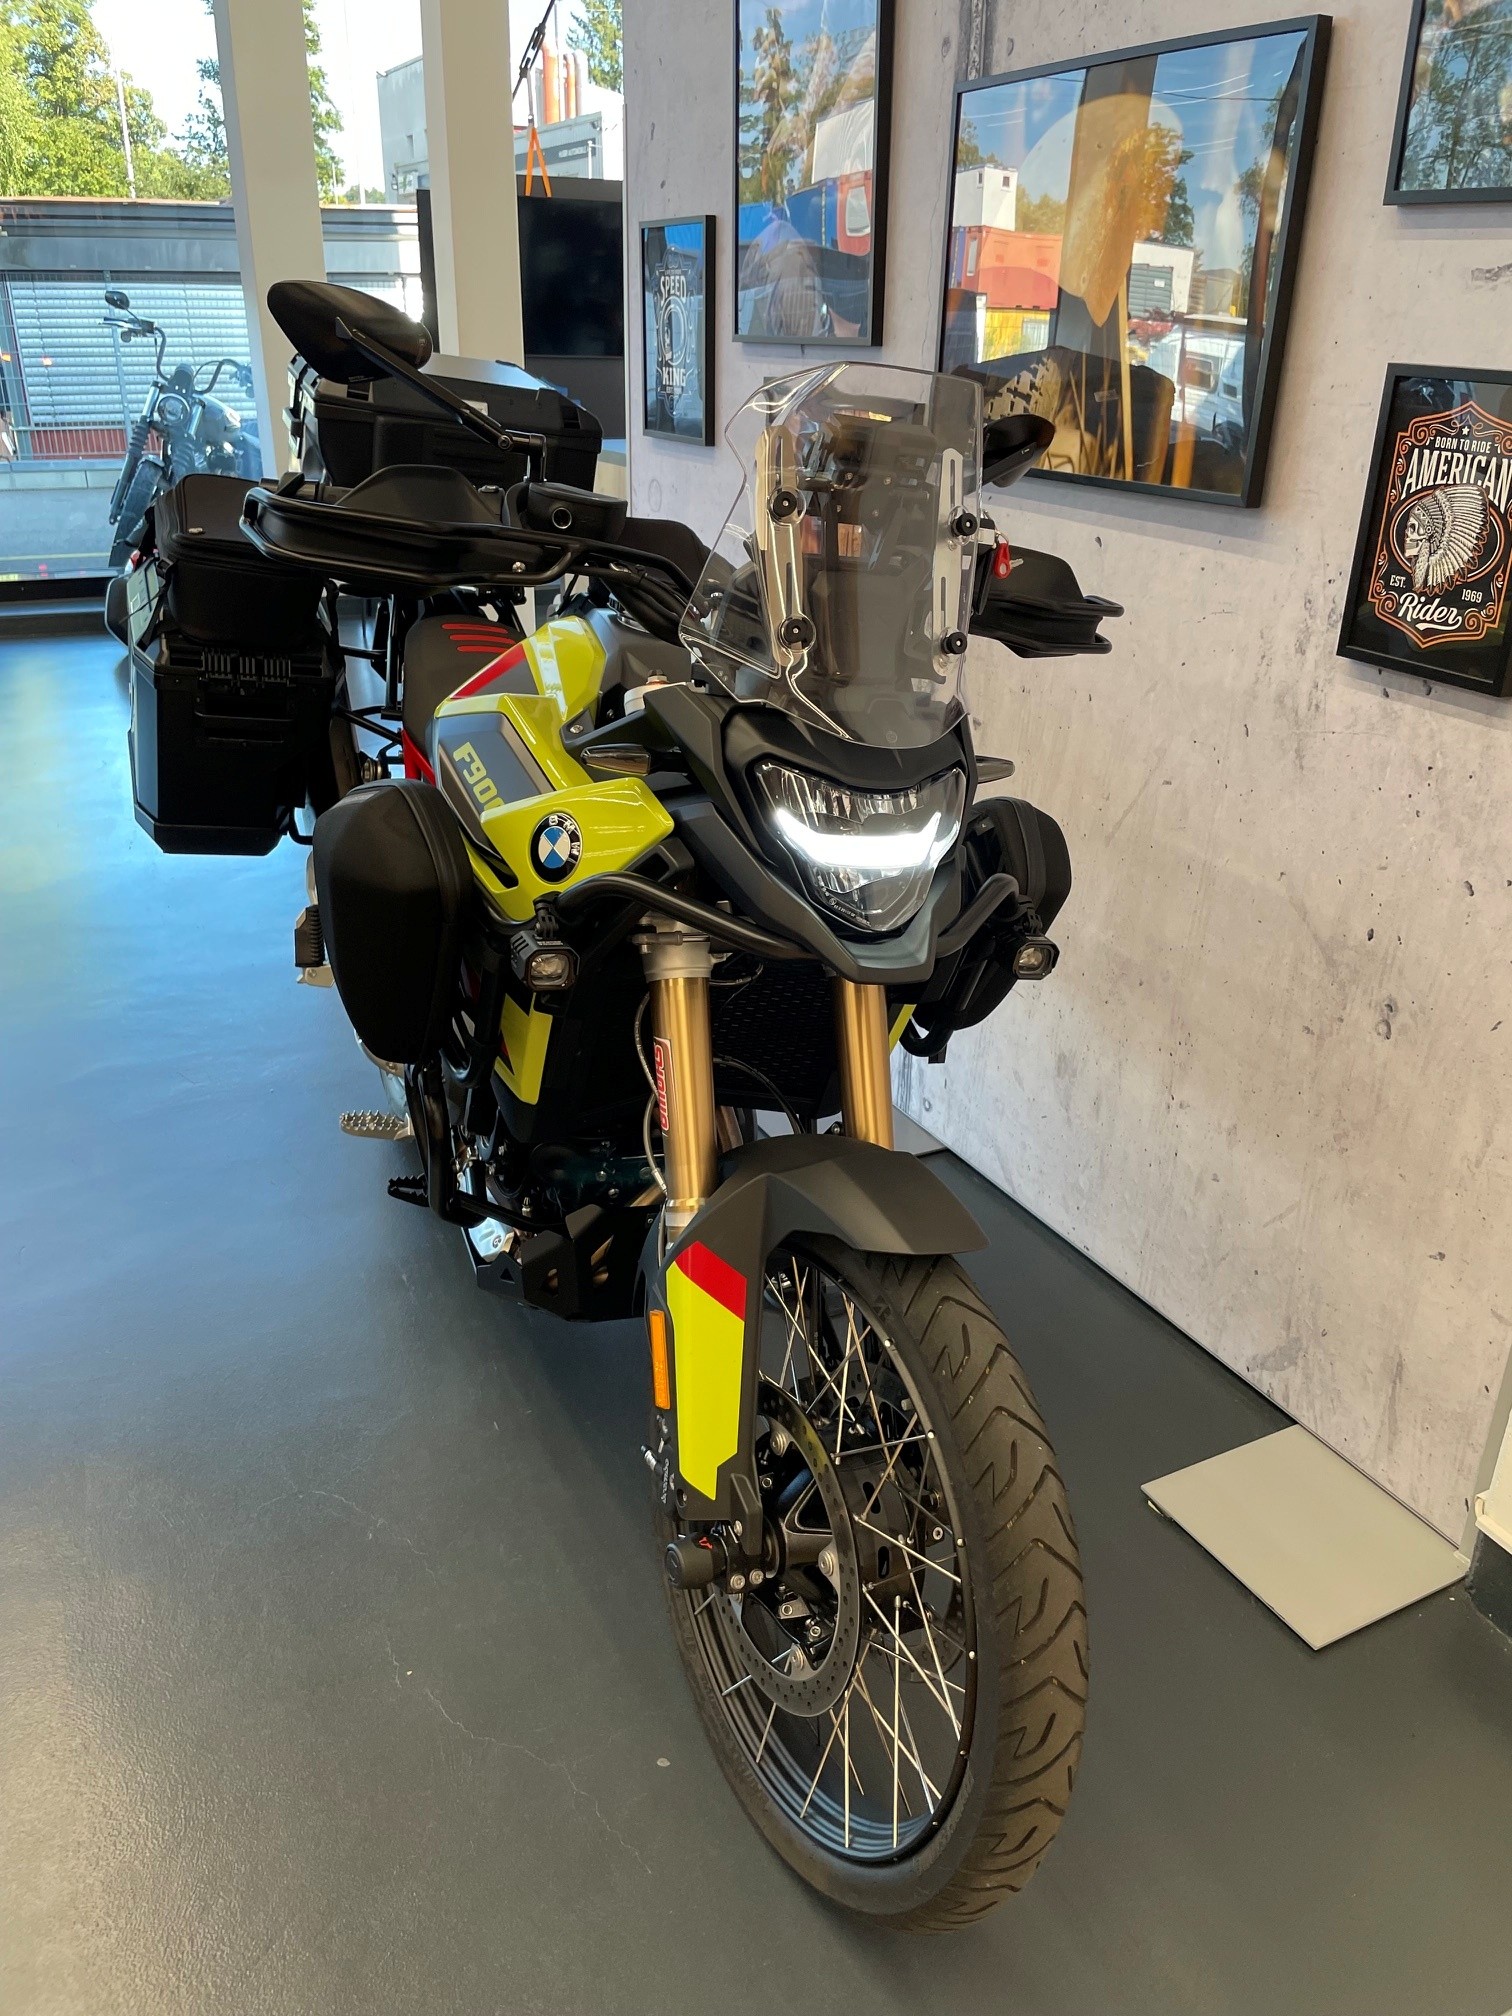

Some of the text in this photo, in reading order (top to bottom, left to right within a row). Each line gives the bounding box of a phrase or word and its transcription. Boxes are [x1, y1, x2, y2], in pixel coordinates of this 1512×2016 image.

[660, 275, 687, 305] SPEED
[662, 366, 687, 387] KING
[1435, 436, 1492, 454] BORN TO RIDE
[1400, 447, 1512, 514] AMERICAN
[1389, 574, 1407, 589] EST.
[1461, 588, 1483, 603] 1969
[1397, 592, 1463, 631] Rider
[548, 815, 583, 857] BMW
